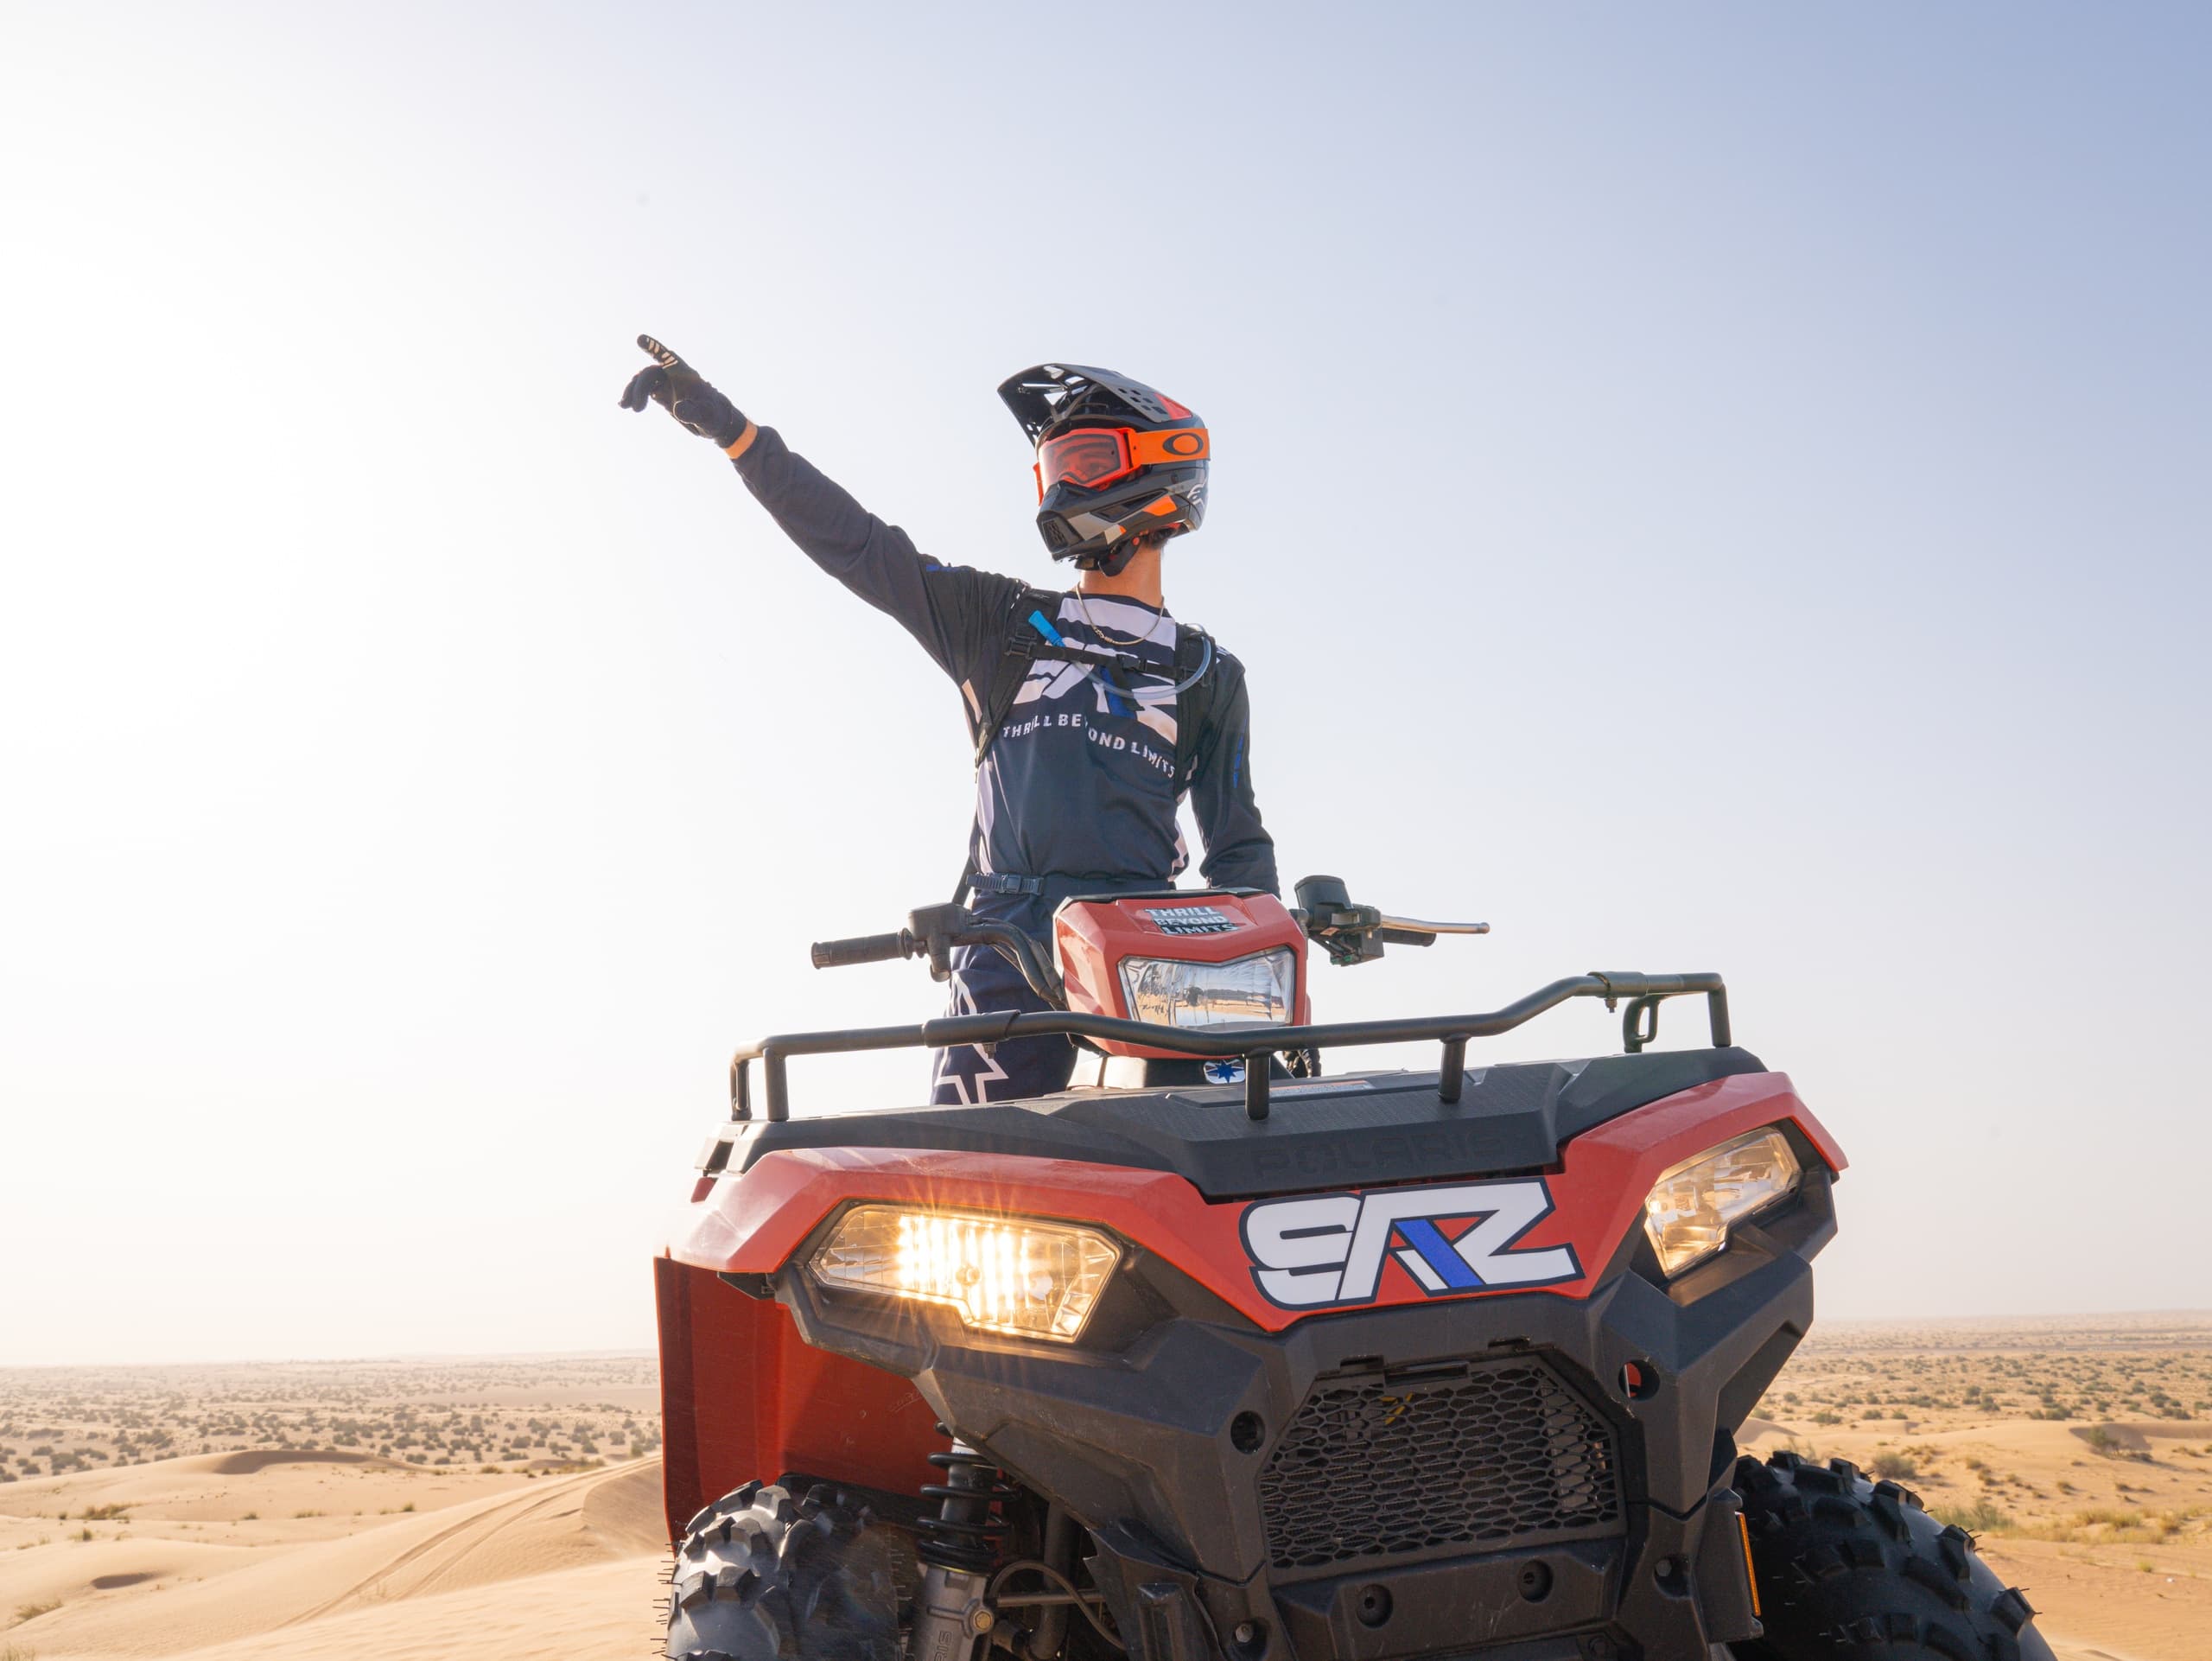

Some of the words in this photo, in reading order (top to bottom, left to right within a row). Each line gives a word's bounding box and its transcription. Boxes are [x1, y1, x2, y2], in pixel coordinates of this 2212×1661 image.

[1002, 714, 1052, 738] THRILL
[1130, 741, 1176, 779] LIMITS
[1145, 907, 1220, 916] THRILL
[1154, 916, 1229, 926] BEYOND
[1162, 924, 1238, 934] LIMITS
